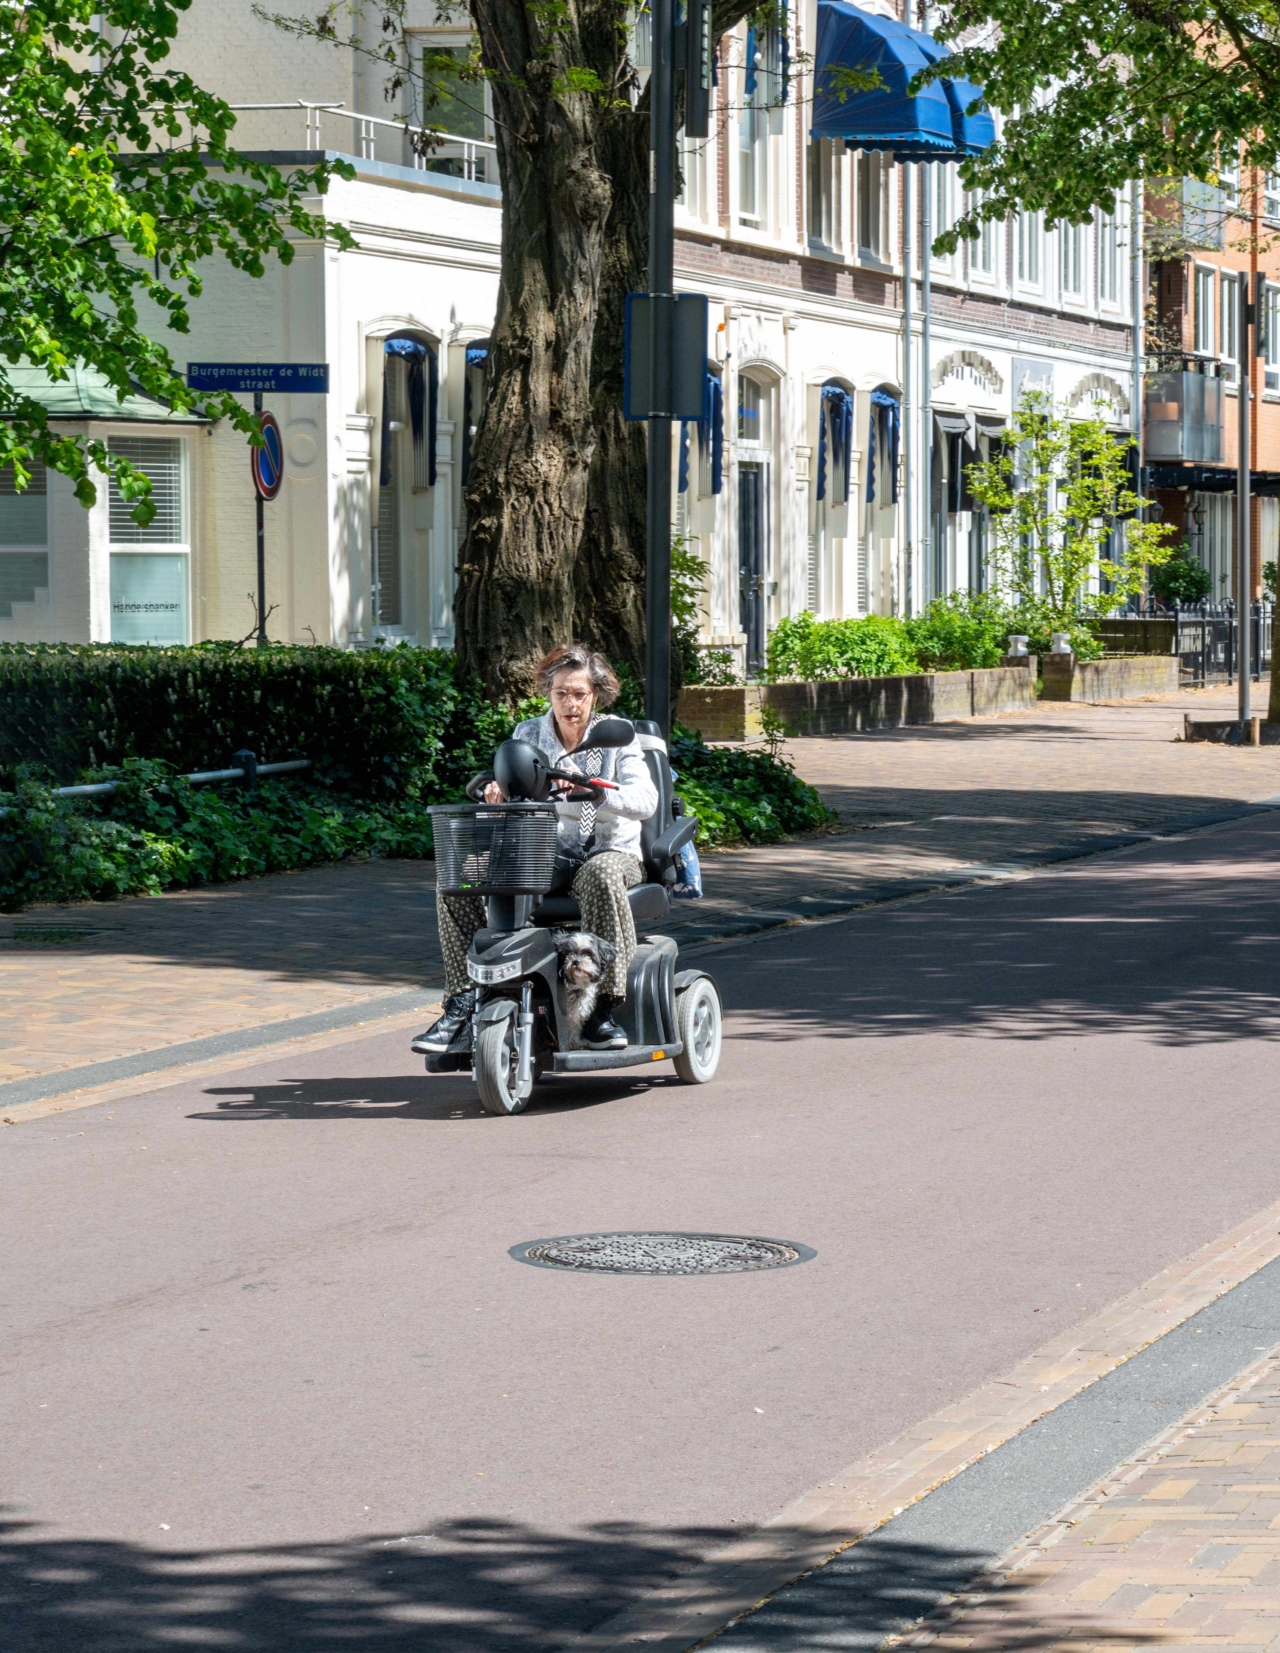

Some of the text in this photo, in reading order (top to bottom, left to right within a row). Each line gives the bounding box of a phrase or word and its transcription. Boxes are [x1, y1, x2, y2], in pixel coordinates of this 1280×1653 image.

[191, 365, 325, 378] Burgemeester de Widt
[240, 380, 276, 389] straat
